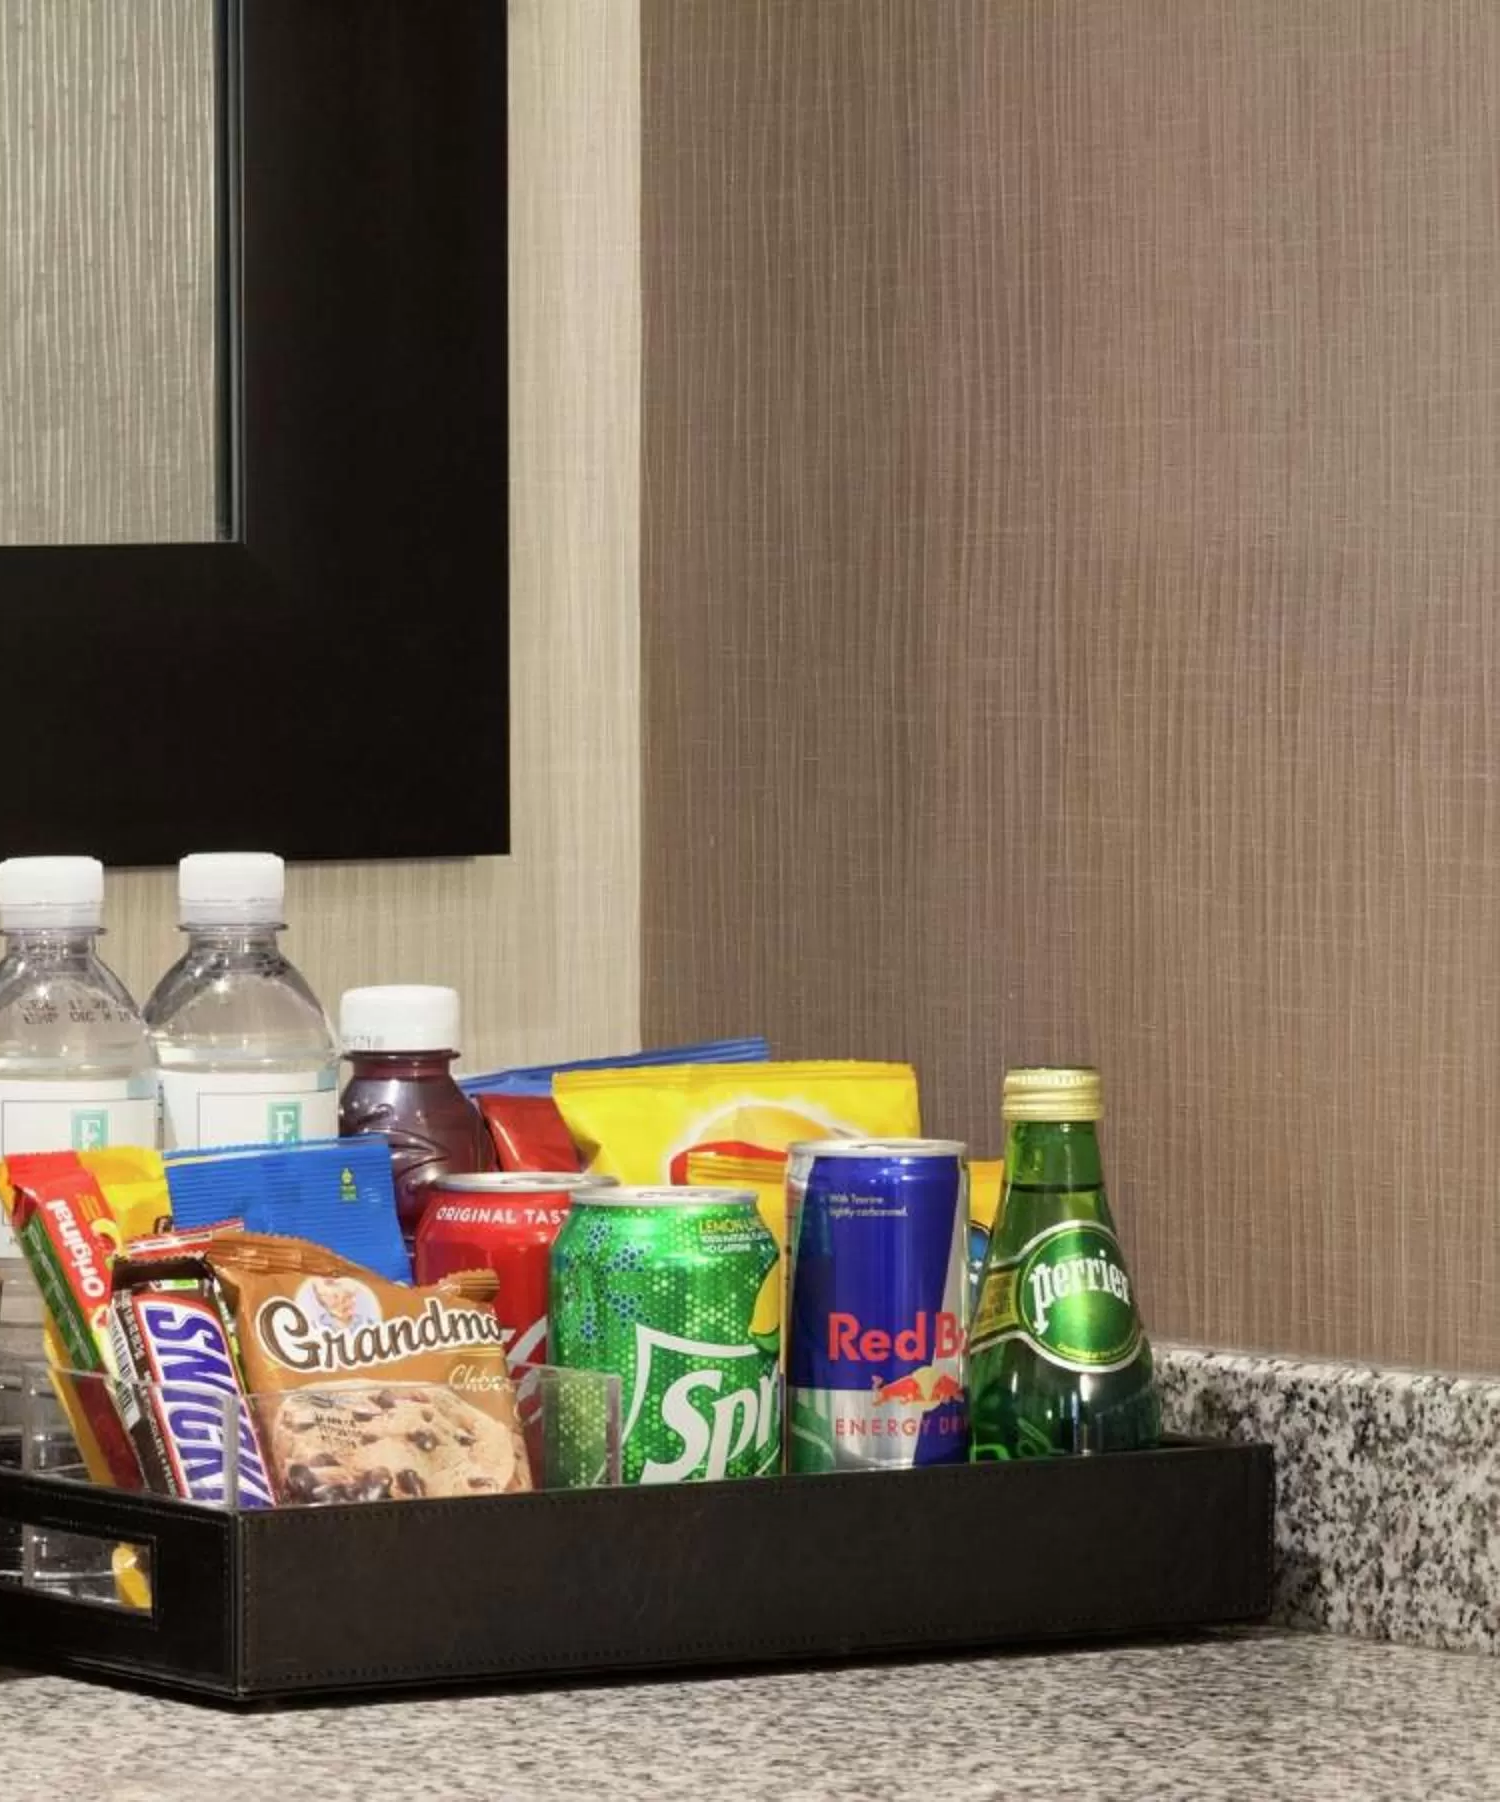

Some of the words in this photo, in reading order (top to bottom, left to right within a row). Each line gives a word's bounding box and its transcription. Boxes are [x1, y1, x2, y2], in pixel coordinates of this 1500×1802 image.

[46, 1199, 105, 1297] Original
[436, 1206, 517, 1223] ORIGINAL
[524, 1208, 570, 1225] TAST
[828, 1312, 927, 1361] Red
[146, 1306, 276, 1508] SNICK
[639, 1361, 779, 1484] Spr
[835, 1416, 931, 1437] ENERGY
